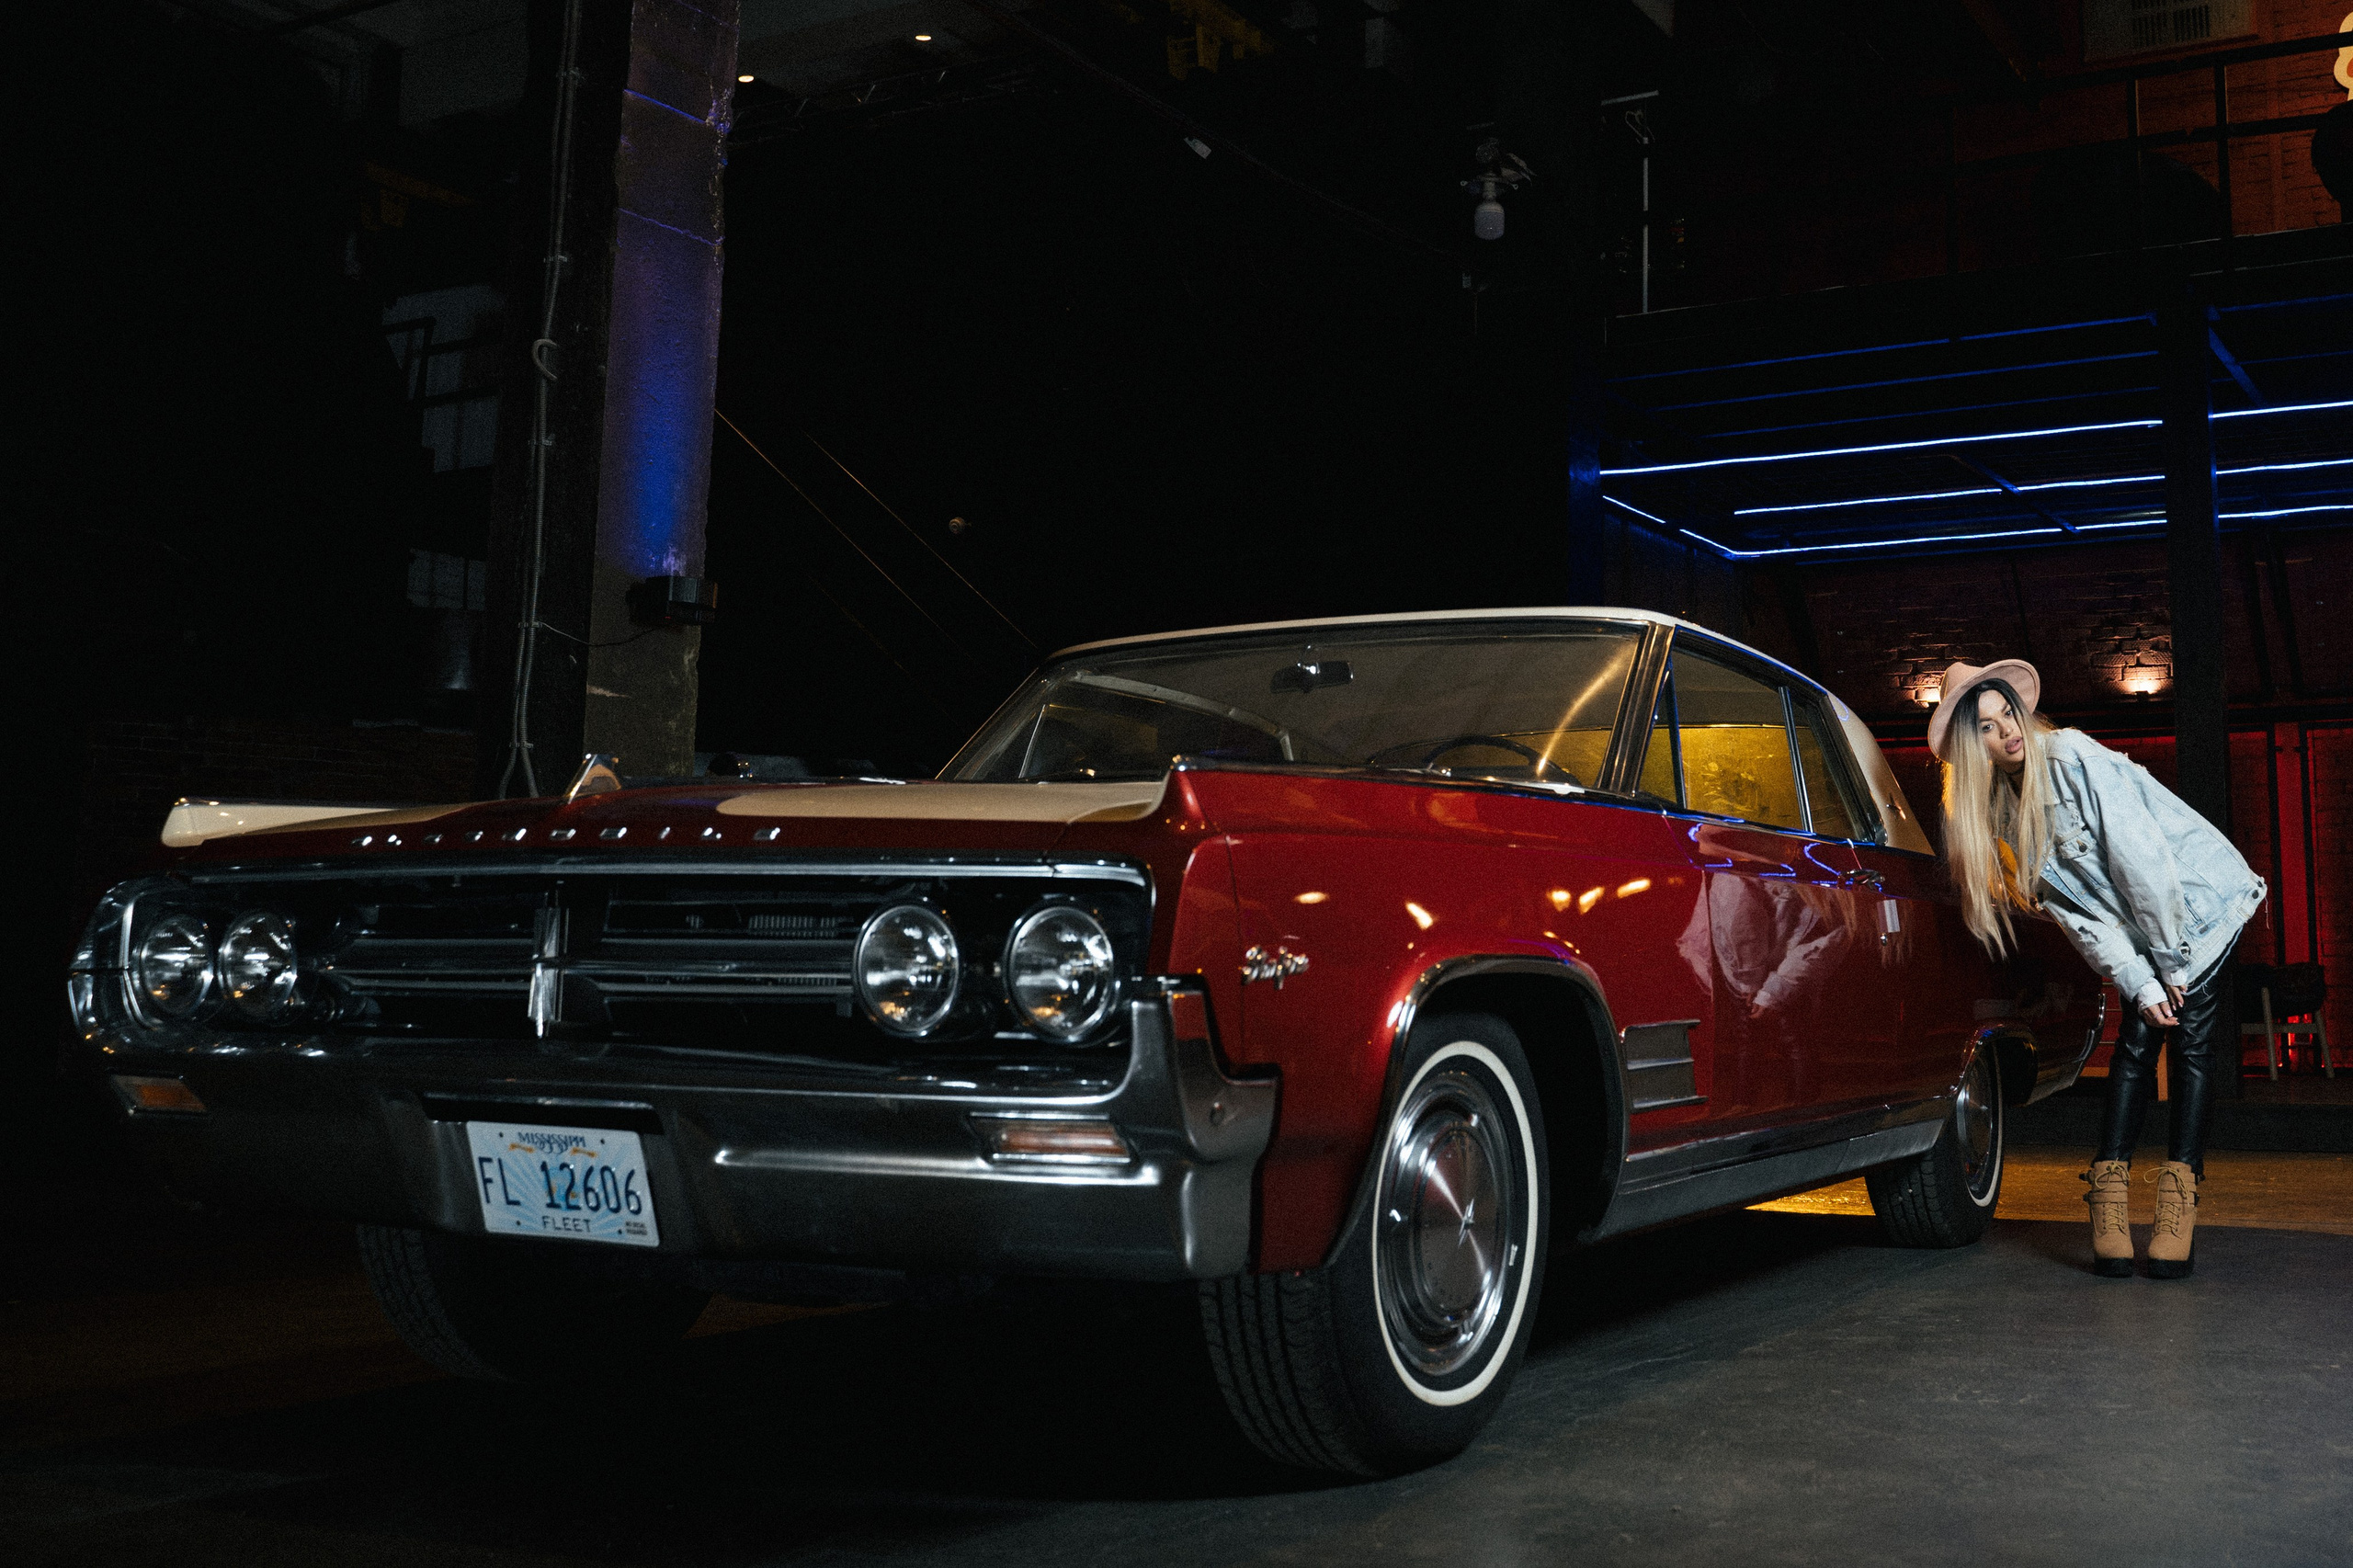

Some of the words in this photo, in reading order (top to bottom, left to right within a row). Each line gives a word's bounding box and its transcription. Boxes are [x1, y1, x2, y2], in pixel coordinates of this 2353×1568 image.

[478, 1156, 520, 1205] FL
[540, 1161, 642, 1214] 12606
[542, 1215, 591, 1233] FLEET
